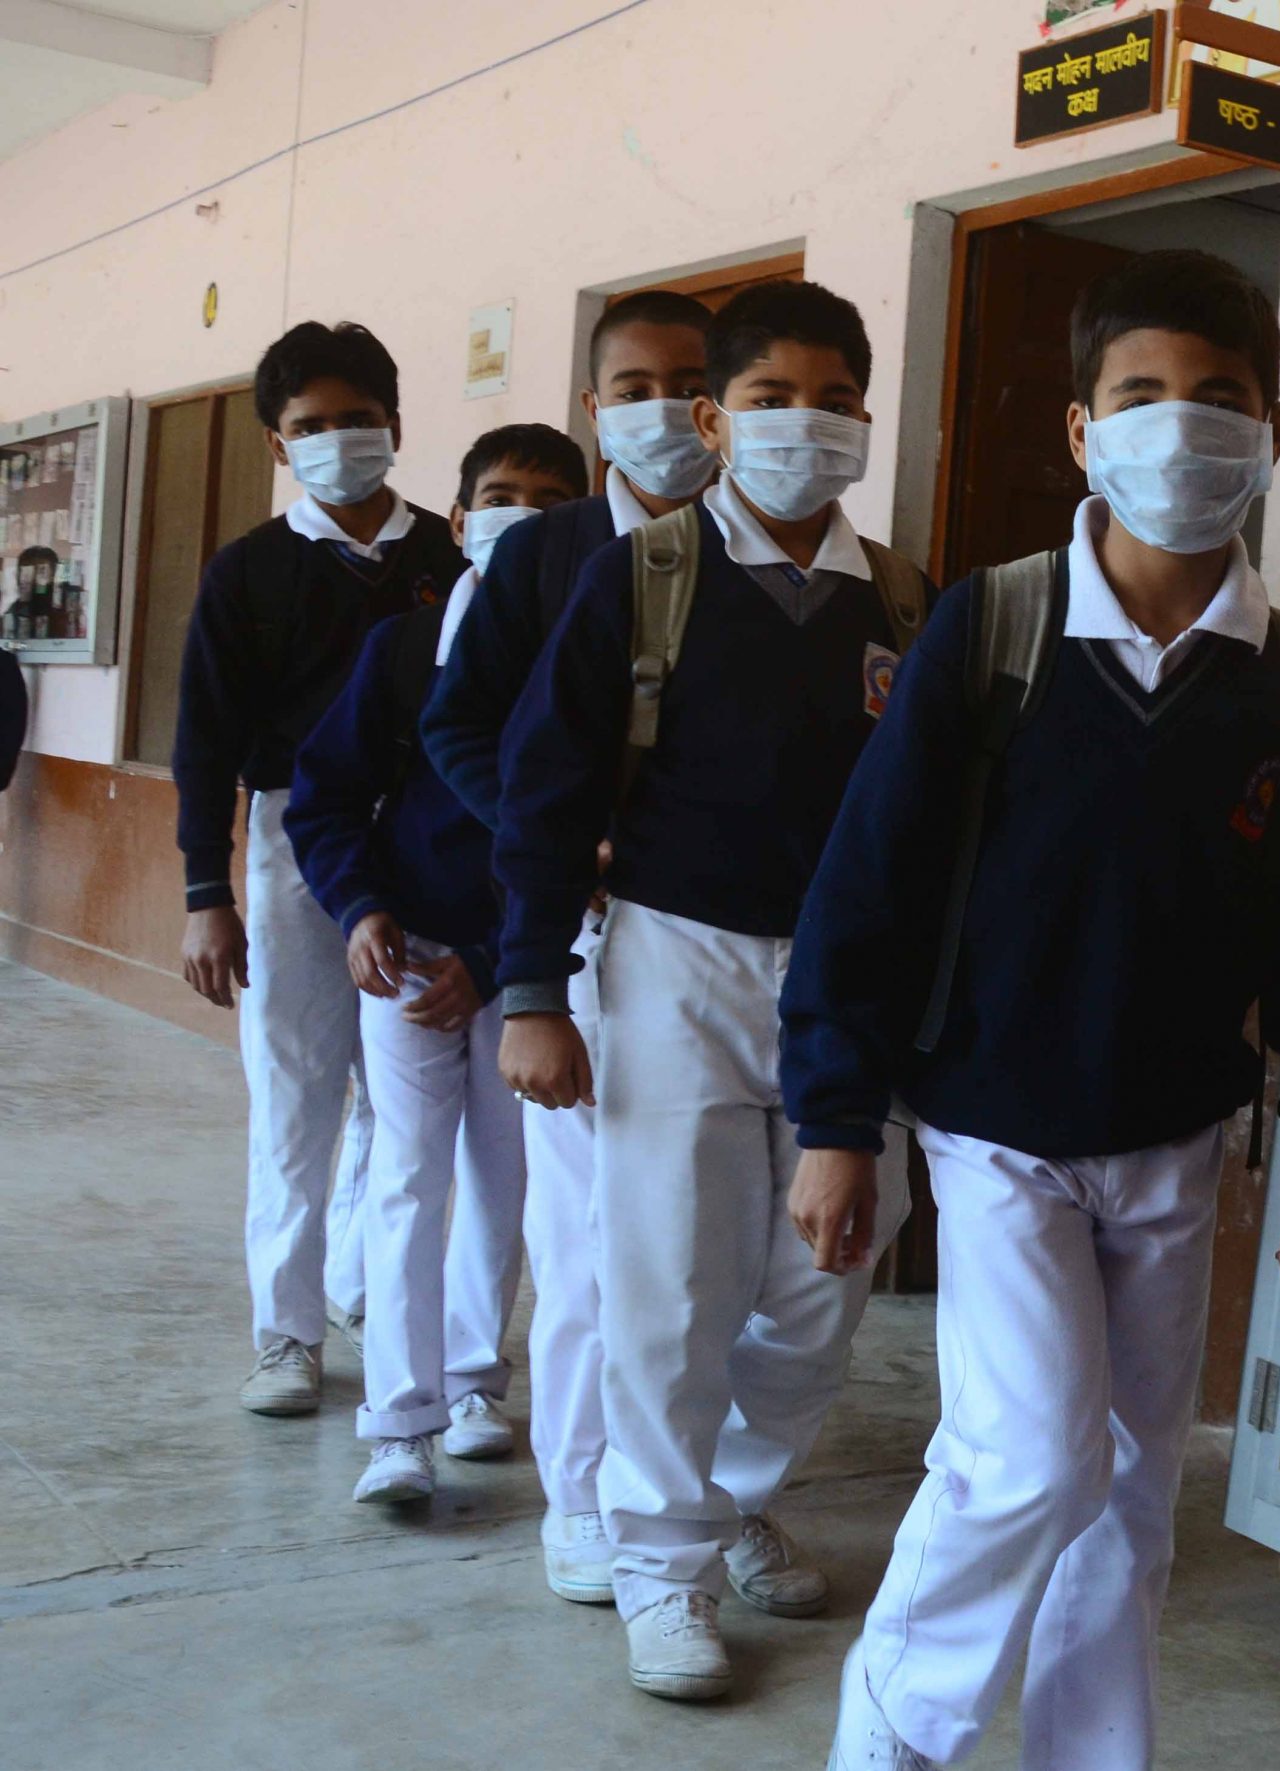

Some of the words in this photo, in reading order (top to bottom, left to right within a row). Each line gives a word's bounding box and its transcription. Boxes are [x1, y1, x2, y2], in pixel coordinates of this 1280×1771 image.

[1056, 52, 1092, 85] मोहन
[1095, 32, 1150, 74] मालवीय
[1067, 88, 1099, 116] कक्ष
[1218, 98, 1260, 130] षष्ठ
